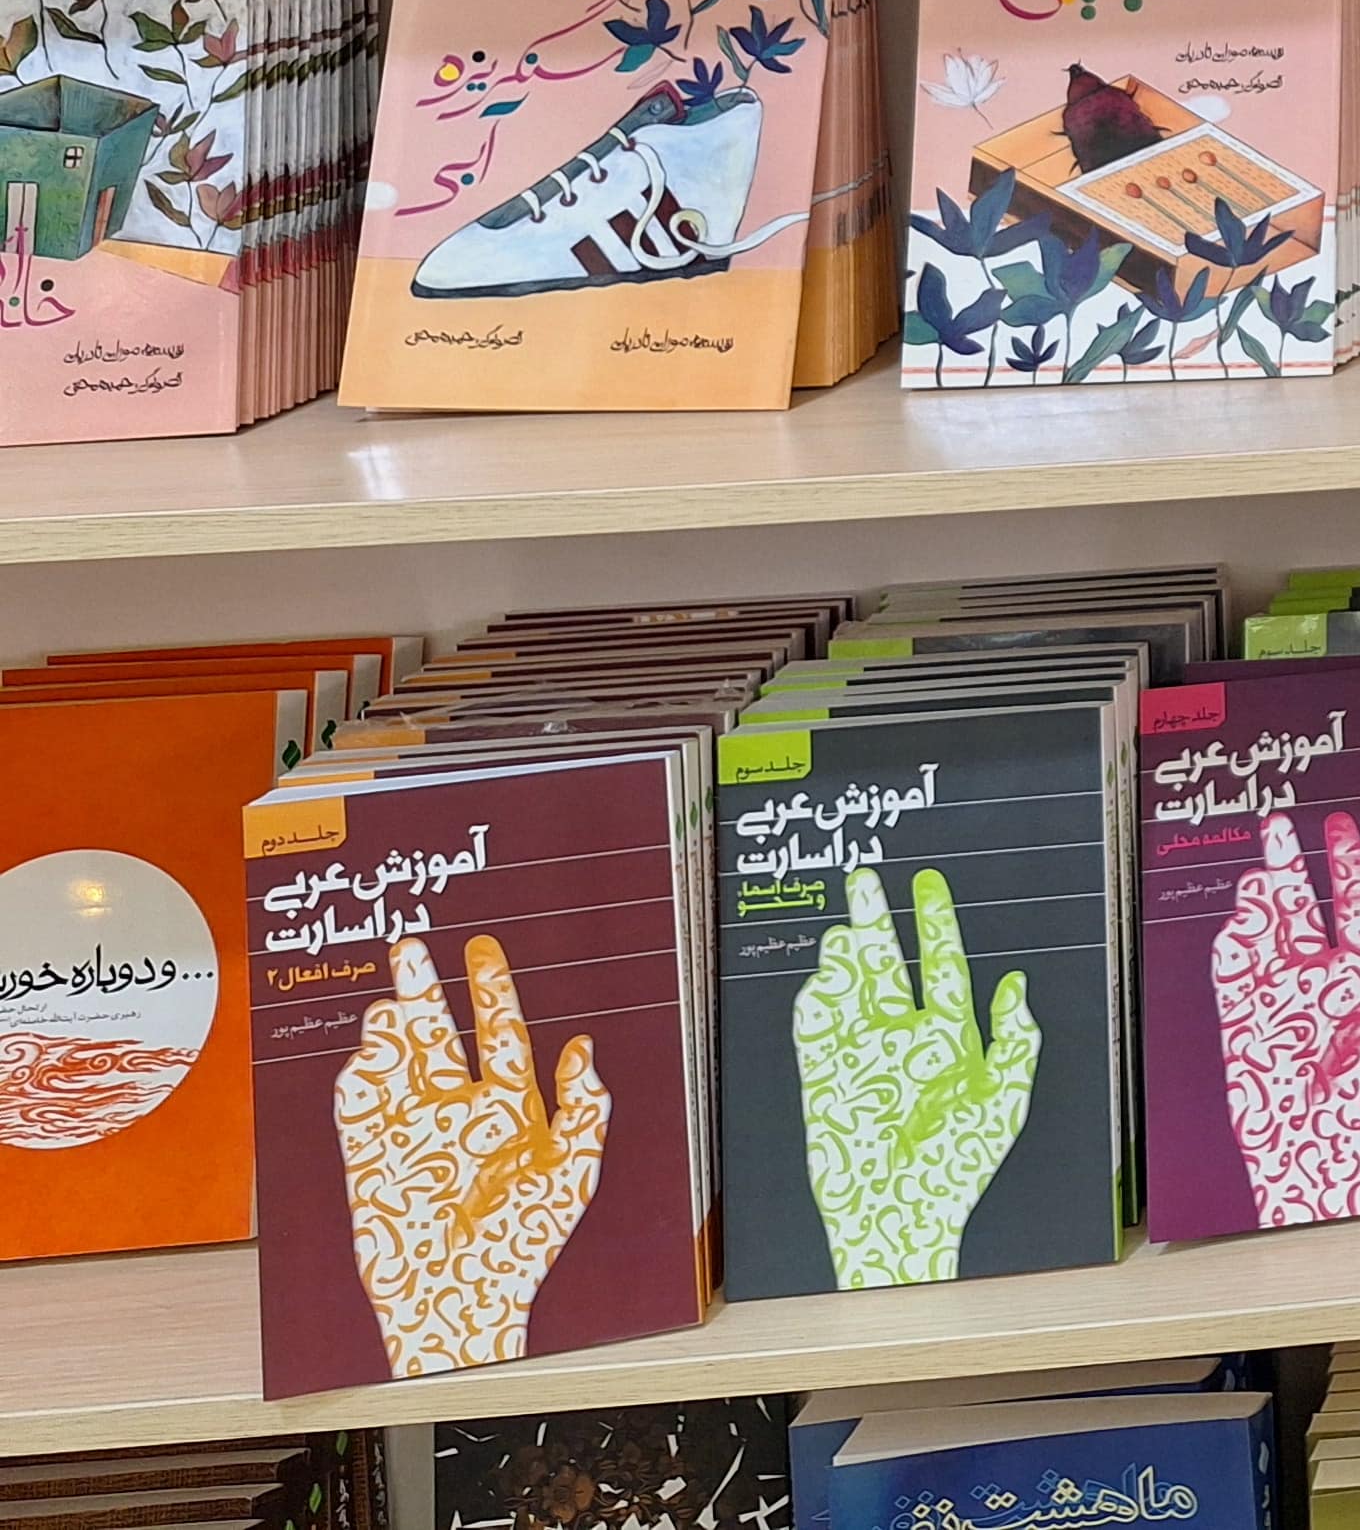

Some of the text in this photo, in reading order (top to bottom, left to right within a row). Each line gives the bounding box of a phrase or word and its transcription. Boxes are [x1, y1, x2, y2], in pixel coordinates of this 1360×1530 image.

[394, 90, 531, 217] آبی
[1283, 639, 1322, 656] جلد
[1192, 706, 1220, 723] جلد
[1229, 710, 1347, 776] آموزش
[735, 756, 806, 781] جلد سوم
[814, 763, 939, 831] آموزش
[1155, 773, 1296, 826] در اسارت
[261, 825, 340, 855] جلد دوم
[736, 827, 883, 880] در اسارت
[1156, 826, 1252, 855] مکالمه محلی
[352, 824, 490, 901] آموزش
[782, 878, 826, 898] صرف
[265, 897, 432, 956] در اسارت
[66, 943, 156, 997] دوباره
[279, 962, 329, 990] افعال
[332, 960, 376, 982] صرف
